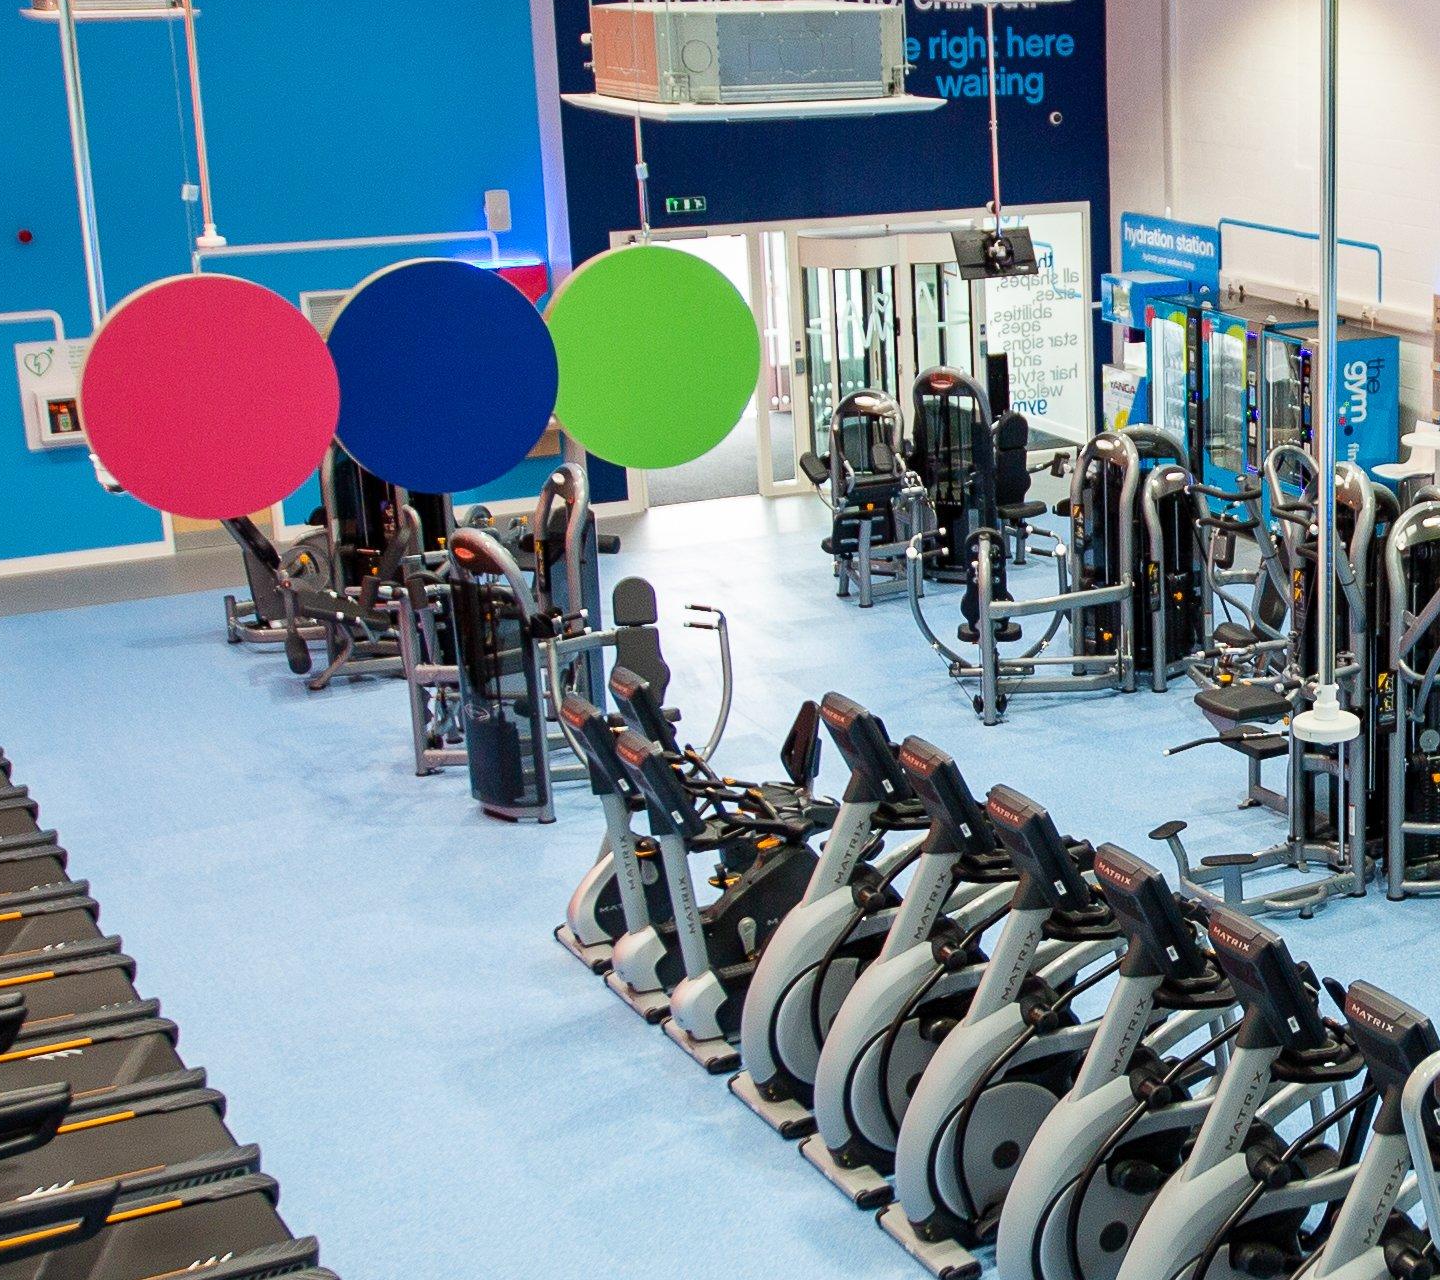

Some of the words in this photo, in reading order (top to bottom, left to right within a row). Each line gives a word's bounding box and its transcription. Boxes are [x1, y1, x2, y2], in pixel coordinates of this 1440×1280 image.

[1007, 26, 1075, 57] here
[1125, 221, 1173, 251] hydration
[1176, 233, 1214, 257] station
[1343, 360, 1367, 423] gym
[1367, 358, 1385, 394] the
[900, 752, 927, 771] MATRIX
[990, 801, 1020, 823] MATRIX
[834, 819, 866, 884] MATRIX
[1098, 861, 1132, 886] MATRIX
[678, 876, 696, 935] MATRIX
[914, 872, 947, 939] MATRIX
[1212, 926, 1251, 952] MATRIX
[1002, 929, 1037, 1001] MATRIX
[1111, 997, 1148, 1074] MATRIX
[1351, 1003, 1395, 1033] MATRIX
[1226, 1070, 1264, 1152] MATRIX
[1364, 1158, 1404, 1245] MATRIX
